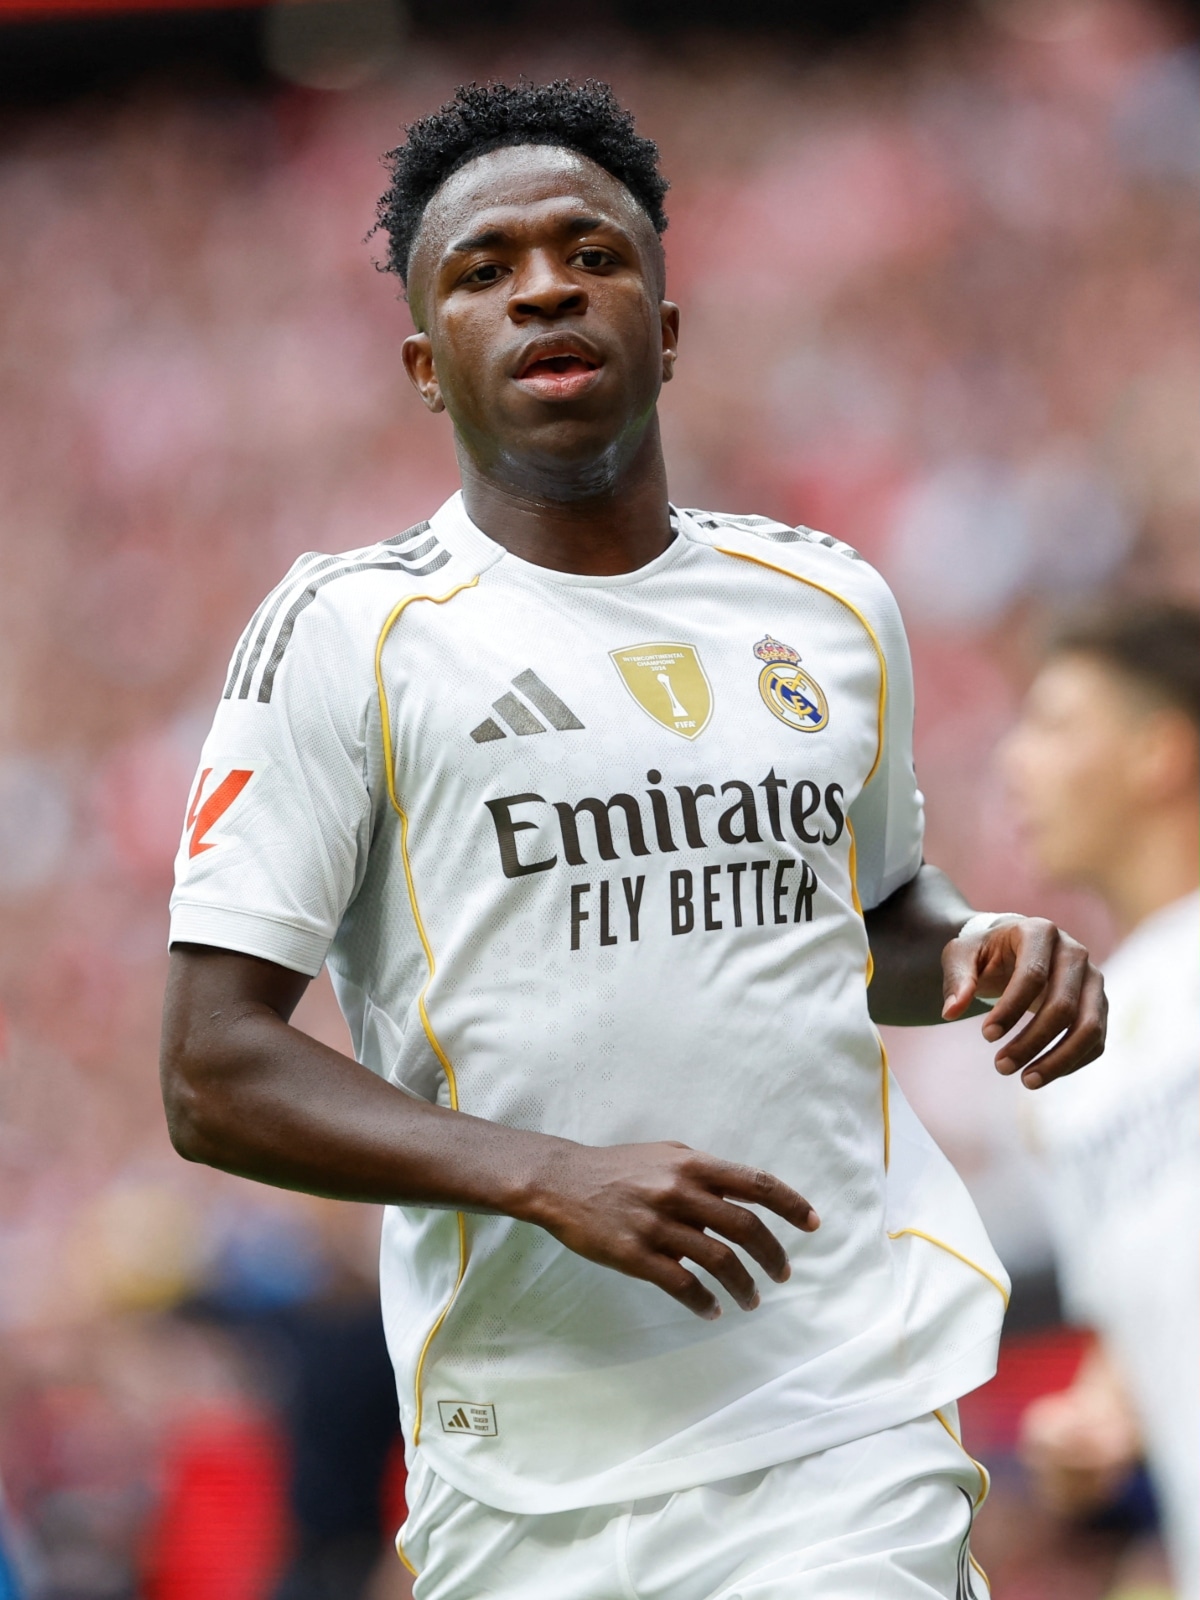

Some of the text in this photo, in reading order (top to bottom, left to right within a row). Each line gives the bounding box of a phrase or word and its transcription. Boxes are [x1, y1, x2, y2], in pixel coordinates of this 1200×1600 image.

[636, 659, 676, 668] CHAMPIONS
[674, 720, 696, 729] FIFA
[483, 766, 845, 879] Emirates
[570, 859, 818, 951] FLY BETTER
